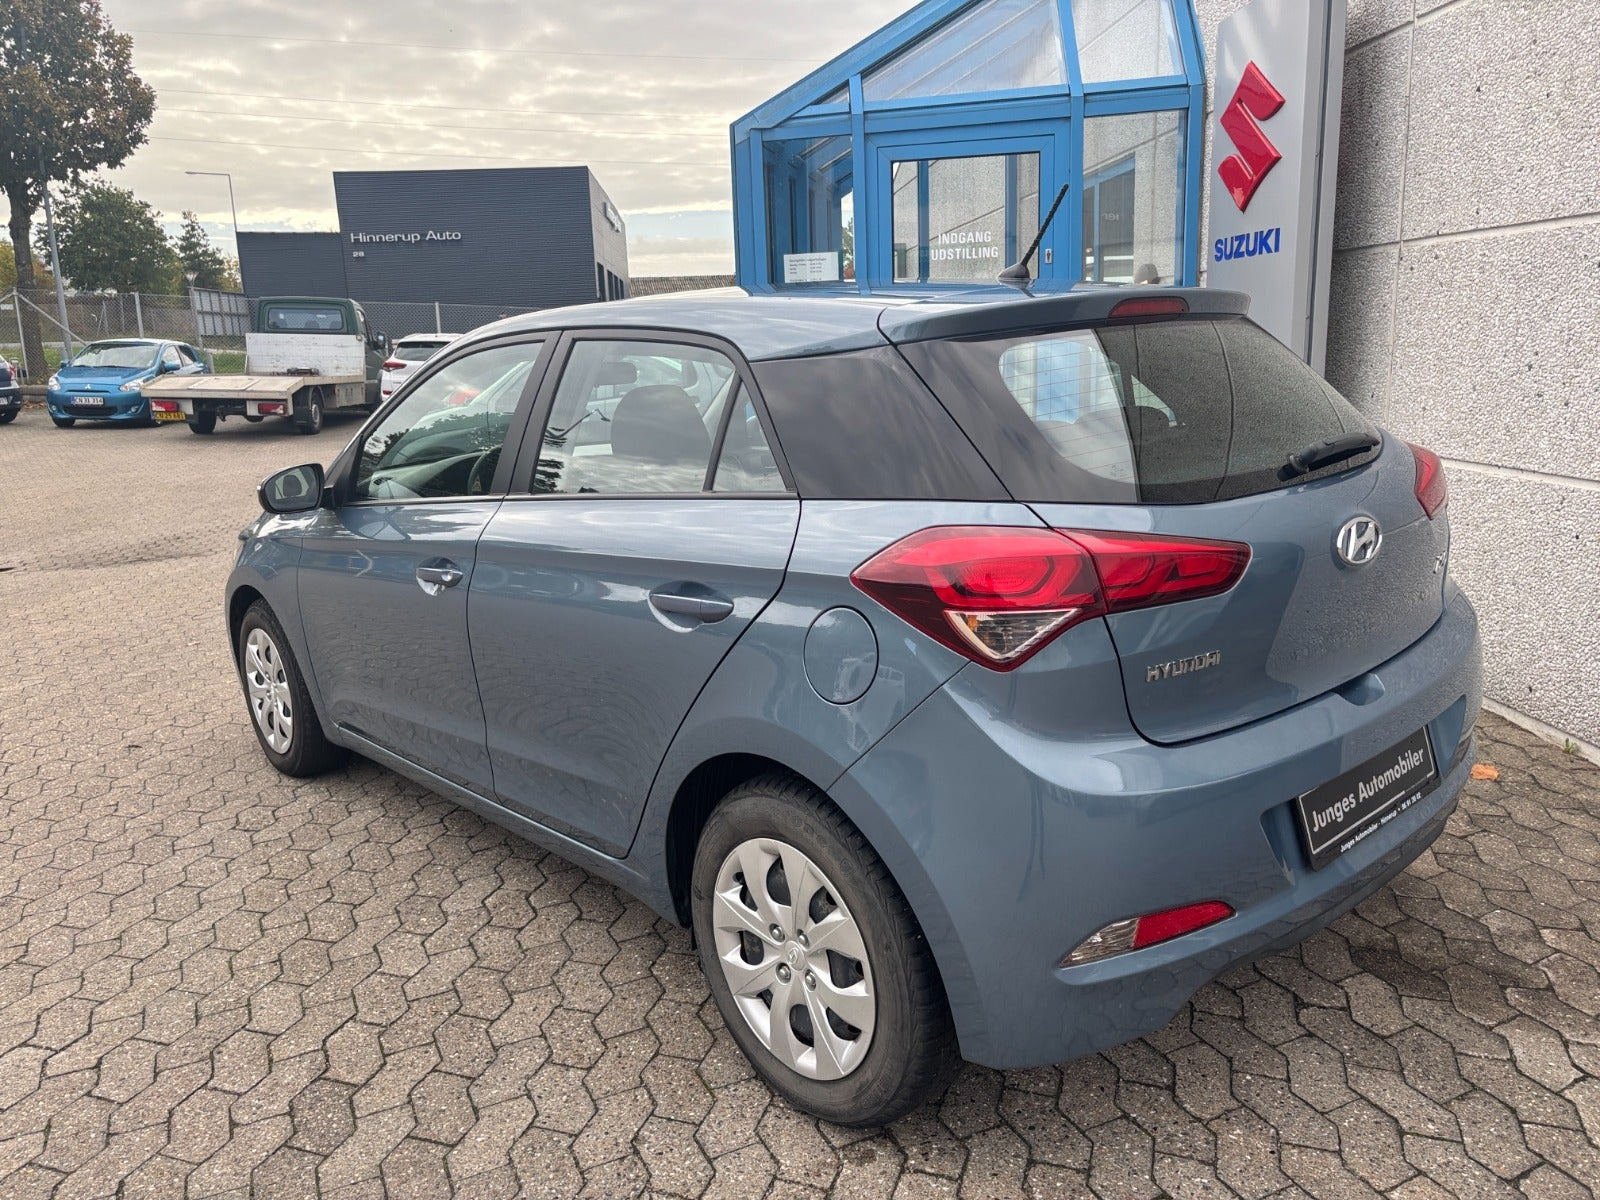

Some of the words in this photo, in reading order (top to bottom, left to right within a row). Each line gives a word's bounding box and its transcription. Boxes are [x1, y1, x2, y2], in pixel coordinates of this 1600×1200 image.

[350, 232, 421, 243] Hinnerup
[425, 230, 462, 241] Auto
[938, 230, 992, 245] INDGANG
[1214, 227, 1281, 262] SUZUKI
[931, 246, 999, 261] UDSTILLING
[1146, 649, 1221, 683] HYUNDAI
[1312, 793, 1357, 832] Junges
[1357, 748, 1424, 803] Automobiler
[1340, 838, 1355, 853] Junges
[1355, 822, 1378, 842] Automobiler
